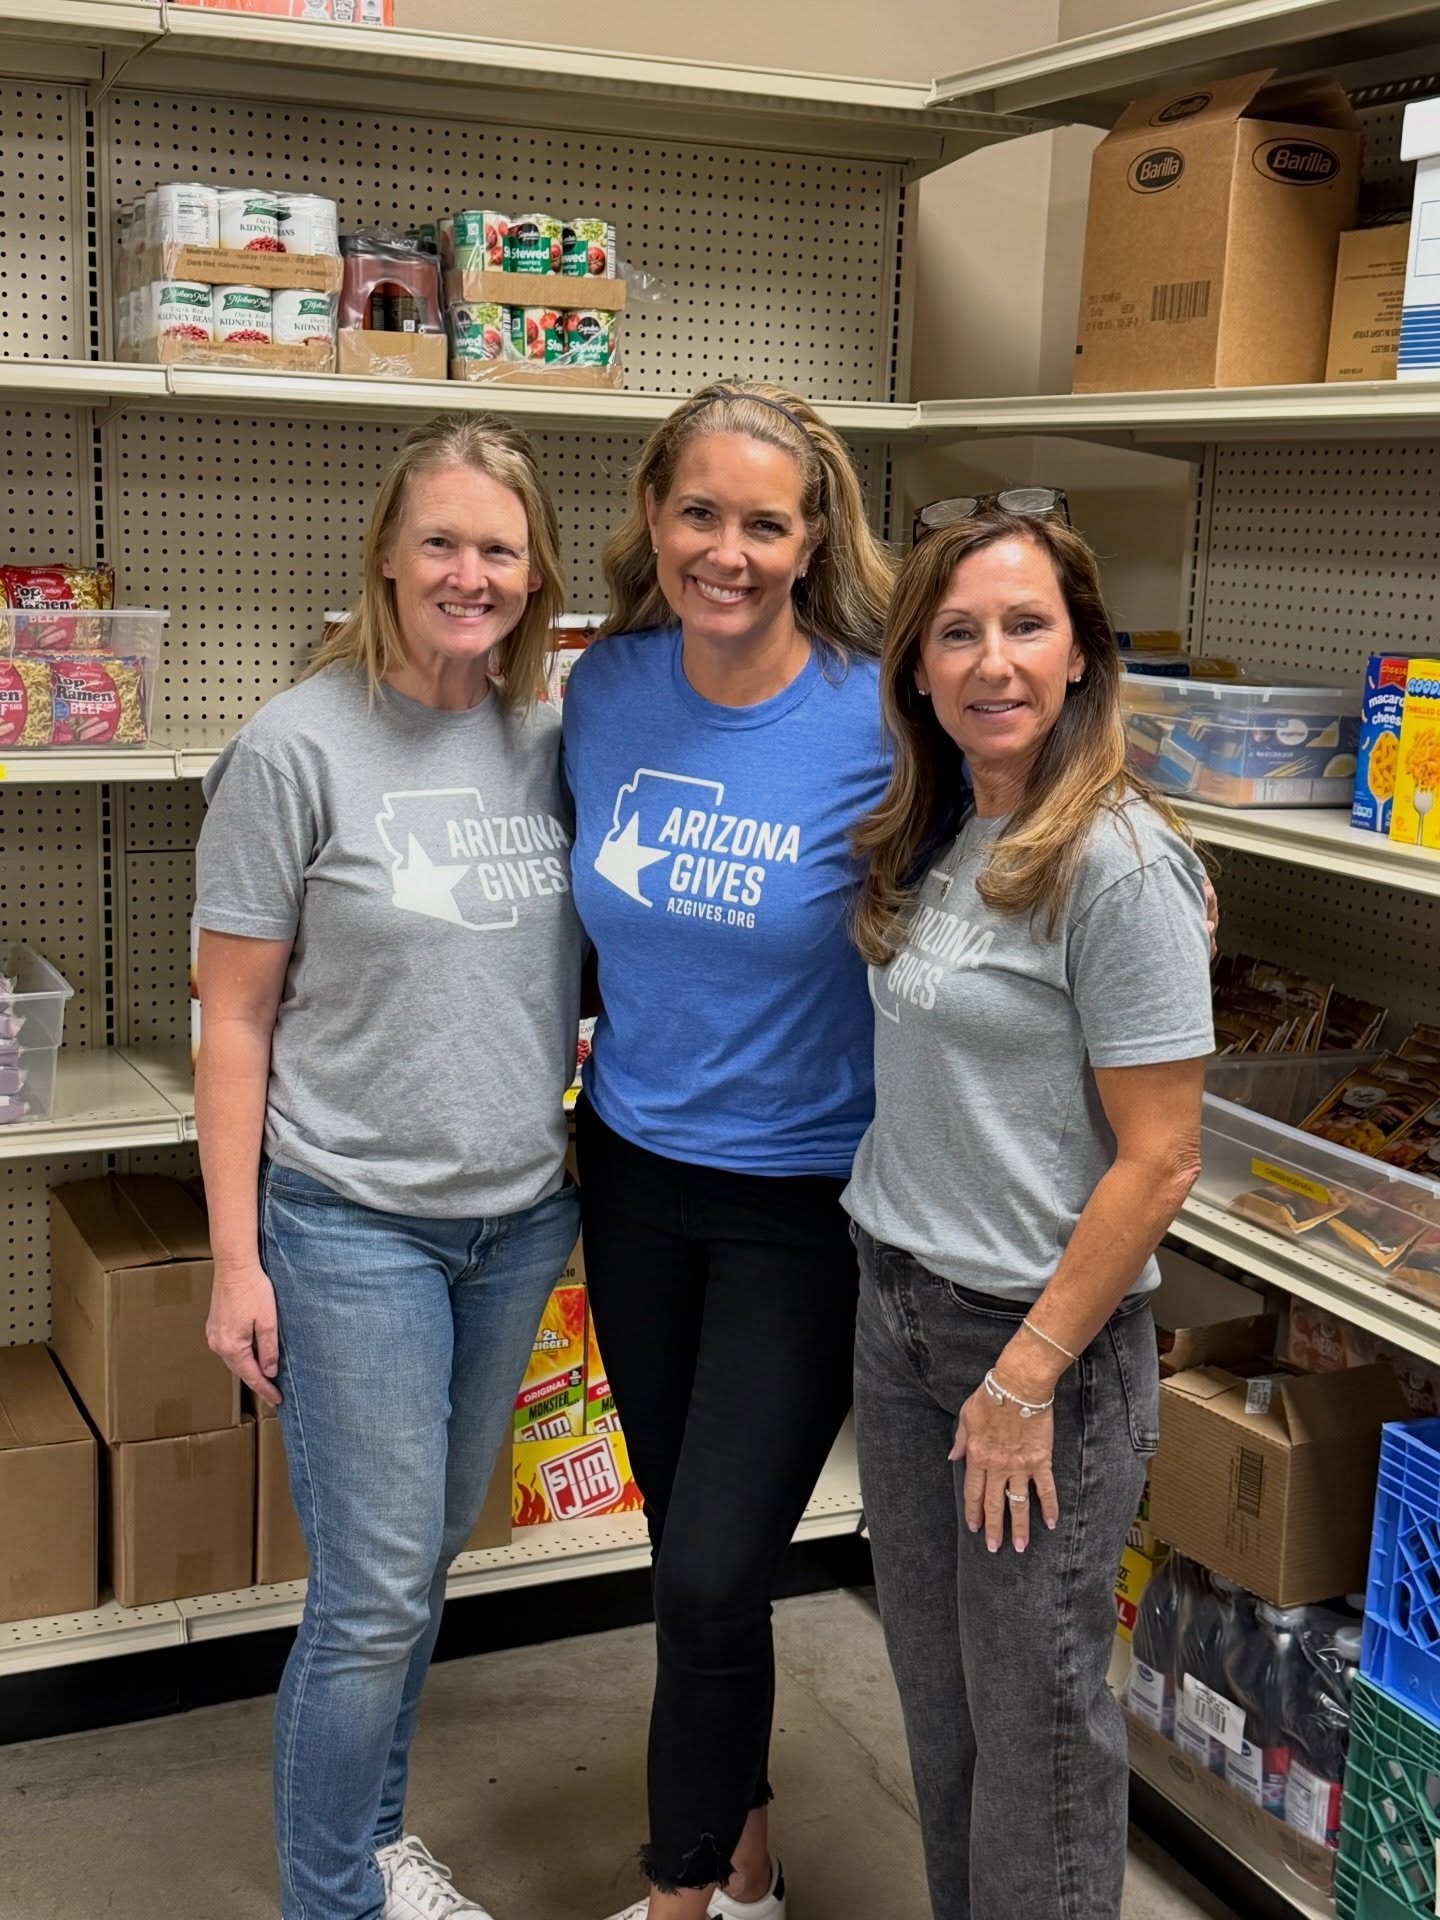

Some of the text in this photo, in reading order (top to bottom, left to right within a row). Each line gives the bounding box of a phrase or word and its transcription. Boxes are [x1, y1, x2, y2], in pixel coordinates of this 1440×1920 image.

[1139, 156, 1180, 181] Barilla
[1272, 150, 1332, 174] Barilla
[239, 224, 271, 233] KIDNEY
[219, 318, 252, 328] KIDNEY
[55, 685, 114, 701] Ramen
[1407, 679, 1440, 698] GOOD
[70, 702, 101, 714] BEEF
[1368, 694, 1404, 709] macaro
[1371, 711, 1402, 726] chees
[447, 814, 570, 858] ARIZONA
[657, 806, 800, 864] ARIZONA
[477, 856, 570, 902] GIVES
[669, 853, 766, 907] GIVES
[666, 897, 756, 929] AZGIVES.ORG
[887, 951, 944, 1010] GIVES
[523, 1378, 568, 1403] ORIGINAL
[529, 1391, 570, 1422] MONSTER
